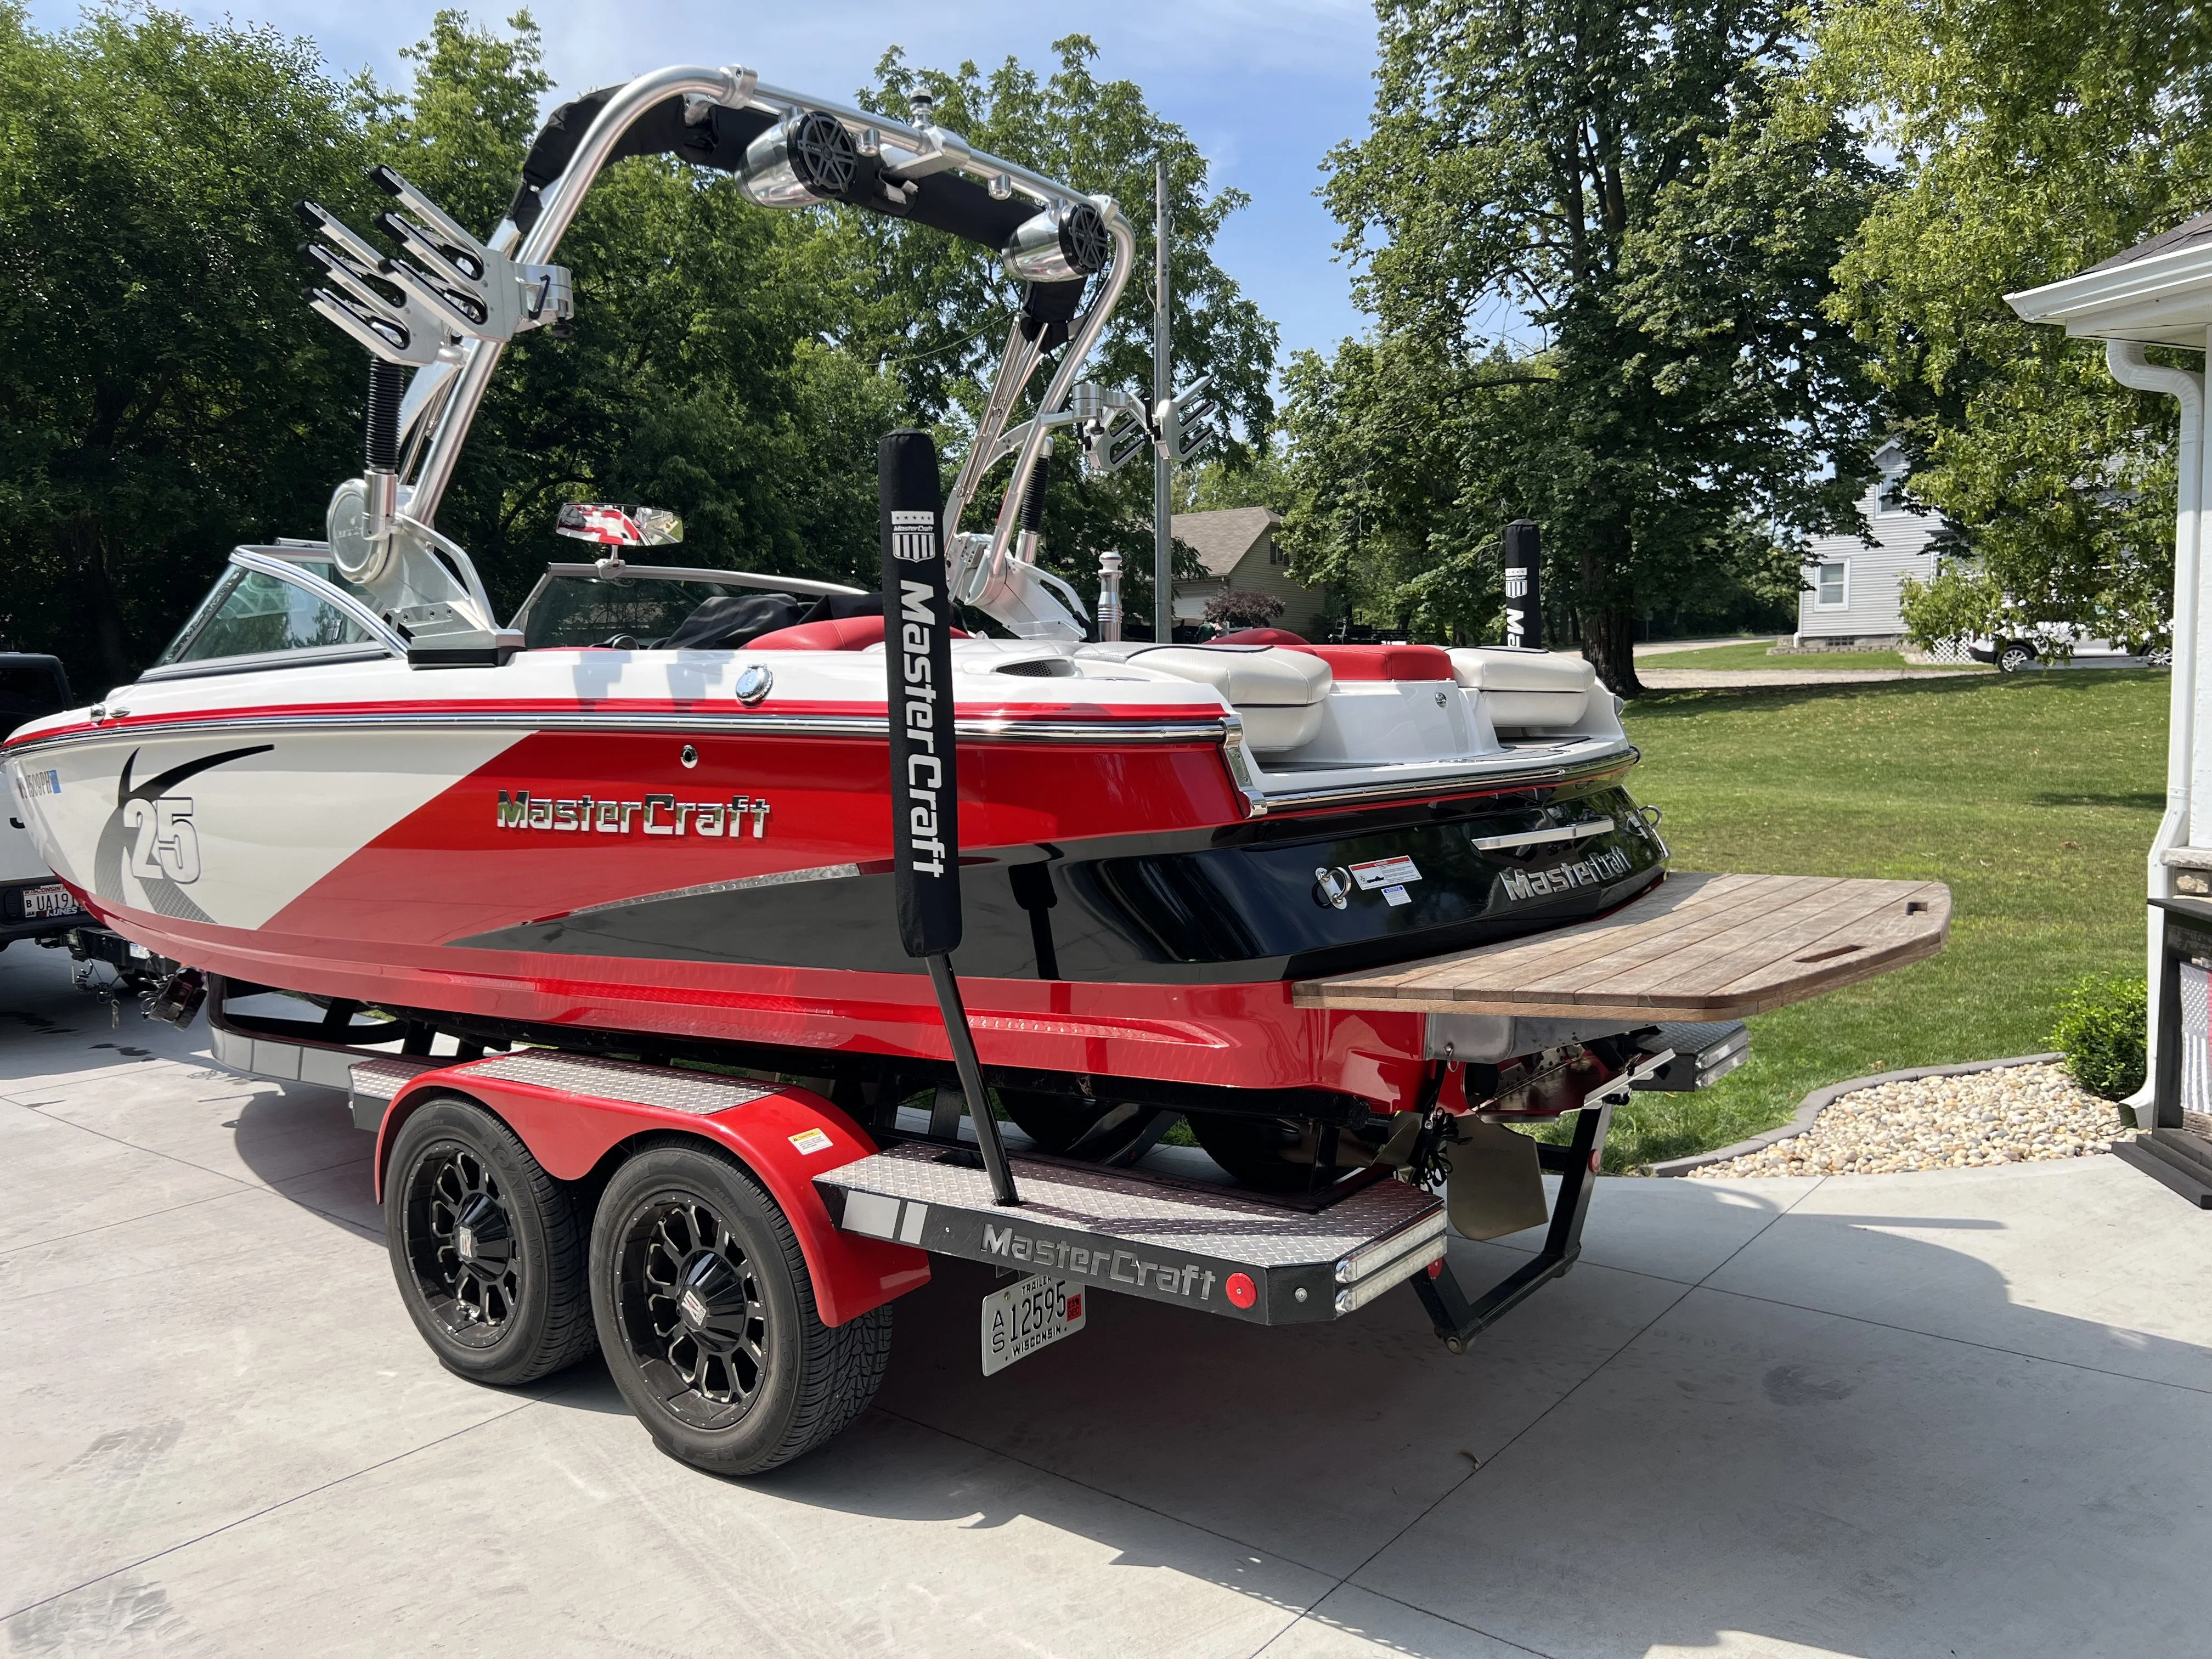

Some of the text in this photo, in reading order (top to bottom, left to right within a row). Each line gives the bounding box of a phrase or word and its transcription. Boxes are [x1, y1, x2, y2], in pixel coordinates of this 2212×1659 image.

[900, 579, 945, 878] MasterCraft
[496, 789, 770, 838] MasterCraft
[123, 797, 201, 884] 25
[1498, 845, 1632, 901] MasterCraft
[26, 900, 32, 909] B
[37, 893, 77, 911] UA191
[981, 1223, 1216, 1300] MasterCraft
[1021, 1276, 1052, 1295] TRAILER
[1010, 1280, 1066, 1342] 12595
[1012, 1324, 1062, 1357] WISCONSIN
